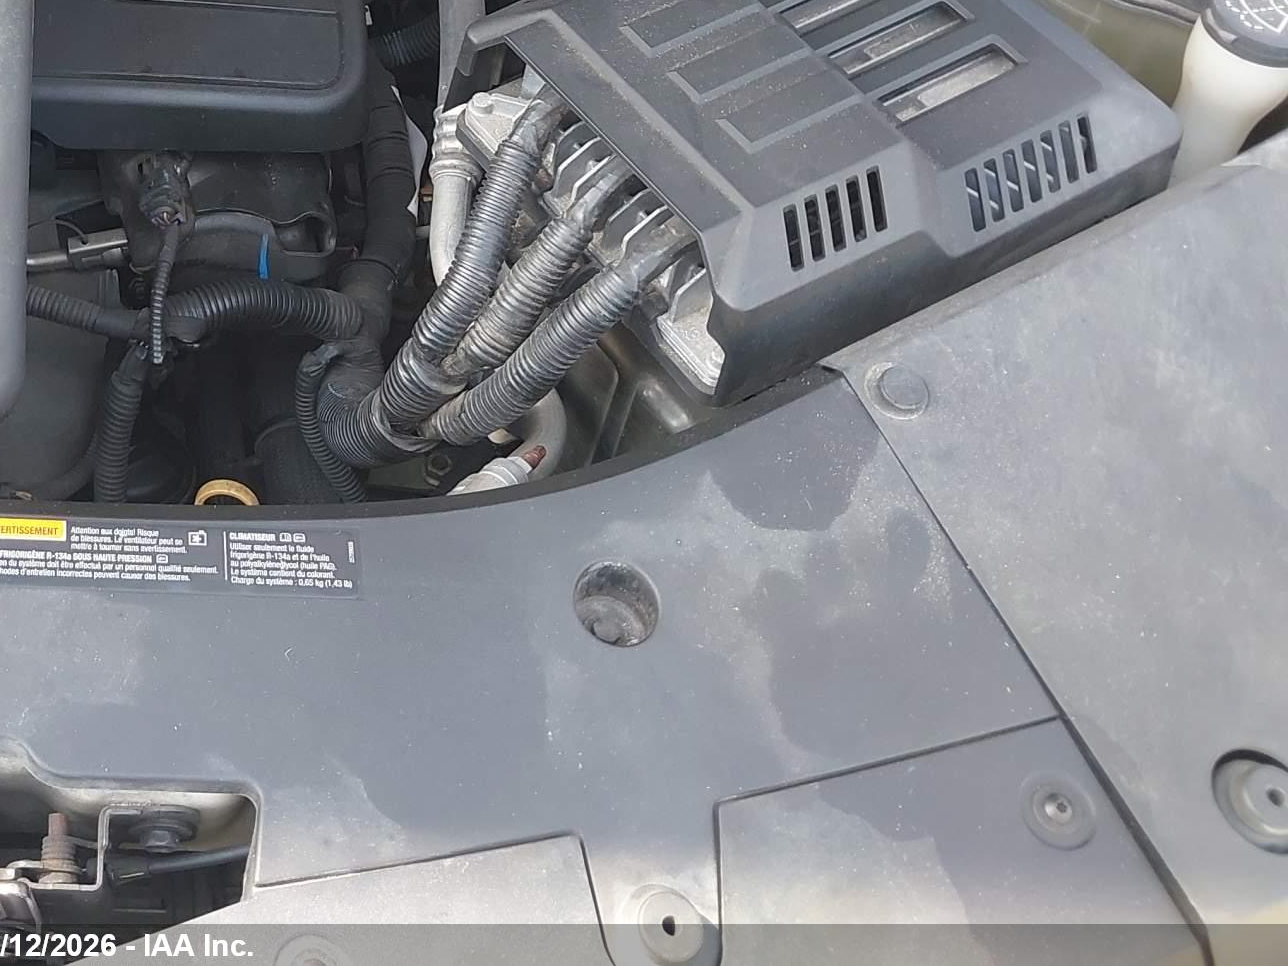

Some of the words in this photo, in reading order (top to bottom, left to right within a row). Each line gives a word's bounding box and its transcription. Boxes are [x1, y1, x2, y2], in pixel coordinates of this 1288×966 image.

[71, 526, 99, 534] Attention
[137, 529, 159, 537] Risque
[229, 532, 276, 541] CLIMATISEUR
[159, 538, 173, 546] peut
[230, 543, 252, 551] Utiliser
[253, 544, 287, 552] seulement
[296, 545, 314, 553] fluide
[0, 549, 46, 559] FRIGORIGÈNE
[47, 552, 71, 560] R-134a
[93, 554, 116, 562] HAUTE
[117, 554, 152, 563] PRESSION
[231, 551, 264, 560] frigorigène
[266, 553, 291, 561] R-134a
[18, 560, 45, 568] système
[60, 561, 74, 569] être
[75, 562, 101, 570] effectué
[102, 563, 113, 571] par
[125, 564, 156, 572] personnel
[56, 570, 92, 578] incorrectes
[94, 571, 119, 580] peuvent
[240, 568, 267, 577] système
[269, 569, 295, 577] contient
[231, 575, 254, 585] Charge
[266, 578, 293, 586] système
[315, 580, 323, 588] kg
[343, 580, 352, 589] lb)
